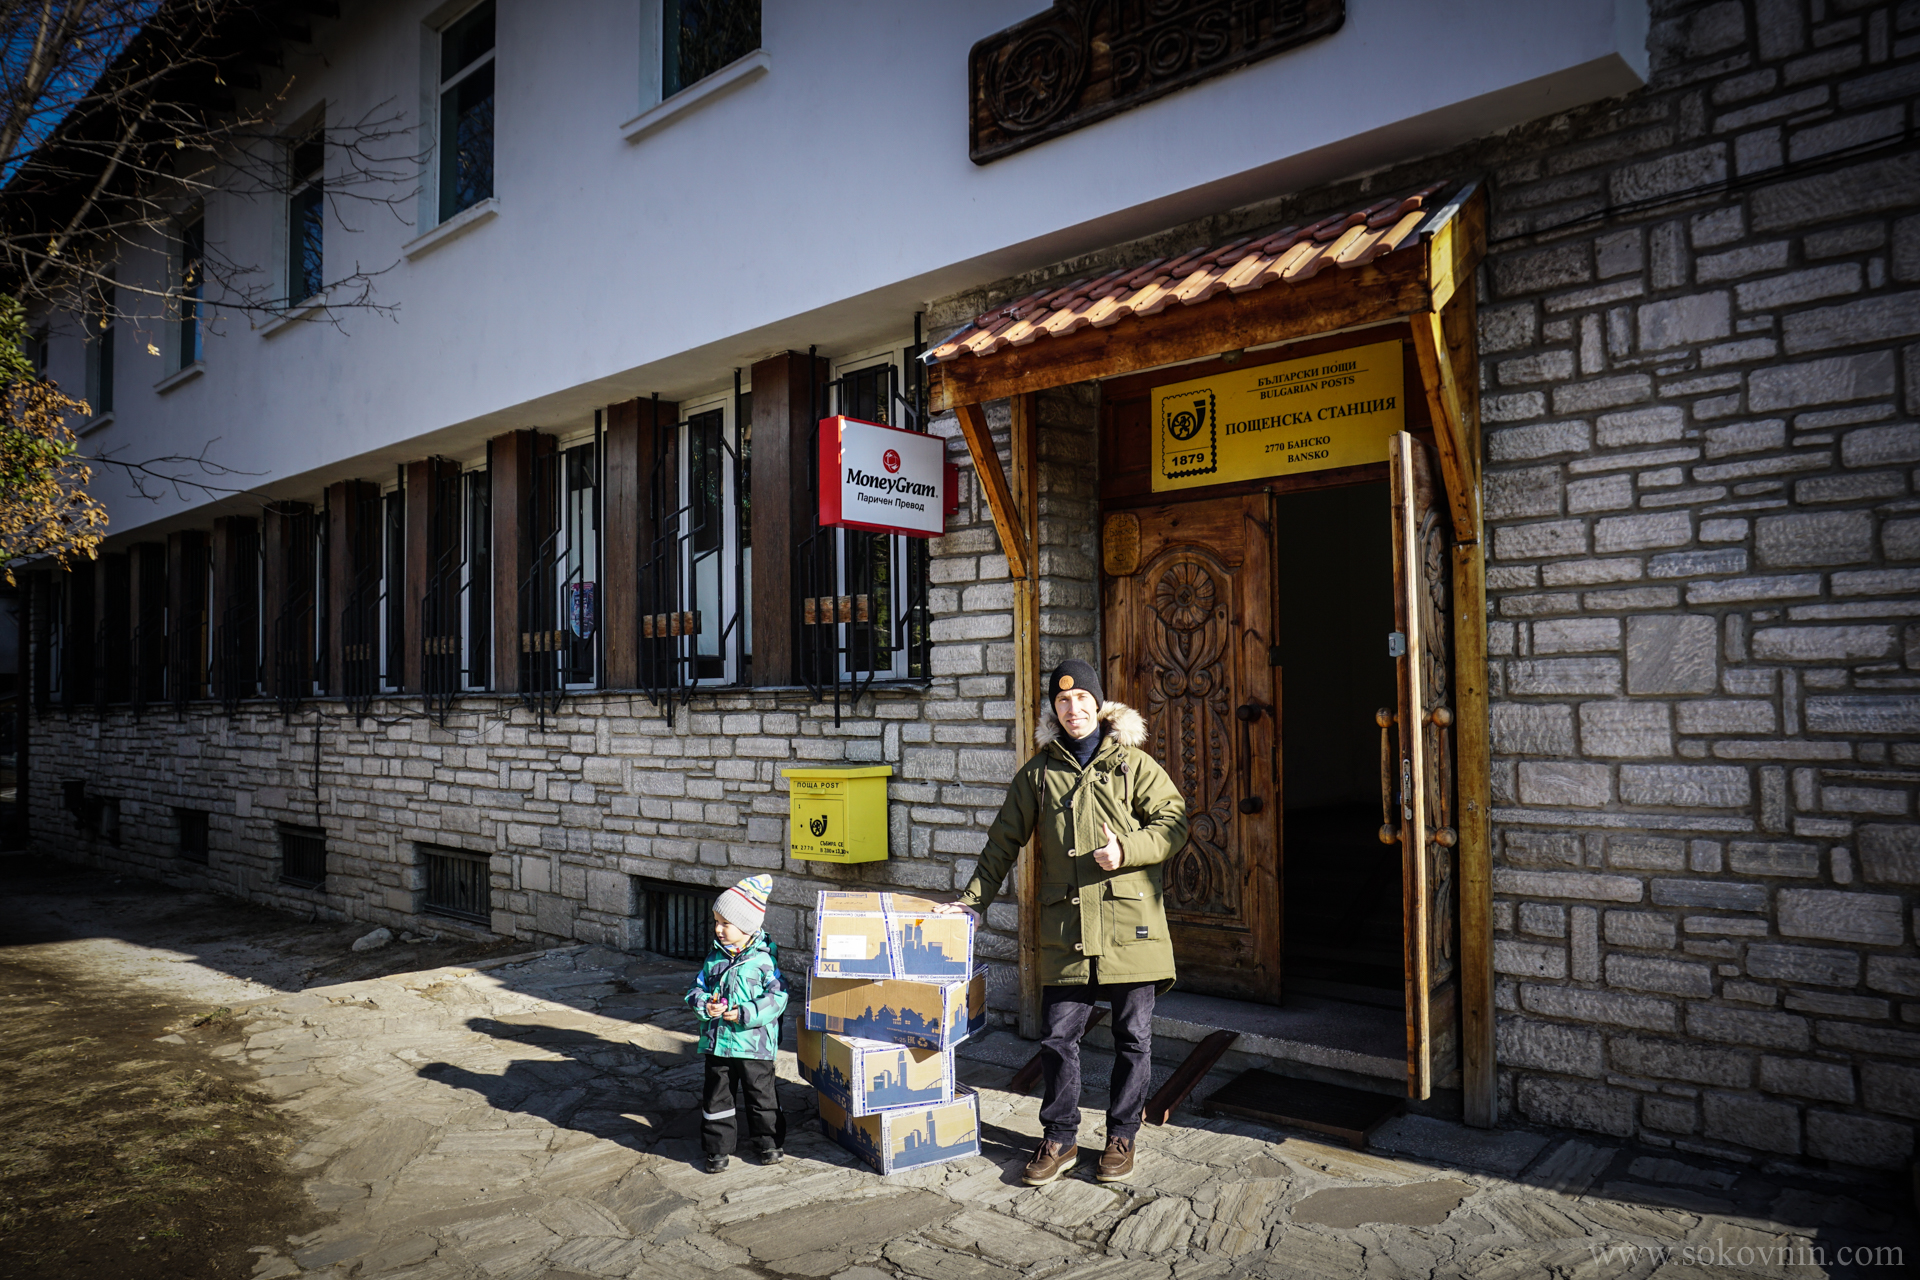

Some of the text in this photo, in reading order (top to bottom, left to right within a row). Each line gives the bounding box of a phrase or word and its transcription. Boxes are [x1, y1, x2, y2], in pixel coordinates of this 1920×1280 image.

[1113, 0, 1308, 94] POSTE
[1257, 361, 1357, 387] БЪЛГАРСКИ ПОЩИ
[1260, 375, 1355, 400] BULGARIAN POSTS
[1225, 396, 1397, 436] ПОЩЕНСКА СТАНЦИЯ
[1264, 435, 1331, 453] 2770 БАНСКО
[1171, 453, 1205, 467] 1879
[1287, 449, 1329, 464] BANSKO
[846, 468, 937, 498] MoneyGram
[857, 492, 925, 512] Паричен Превод
[824, 964, 838, 972] XL
